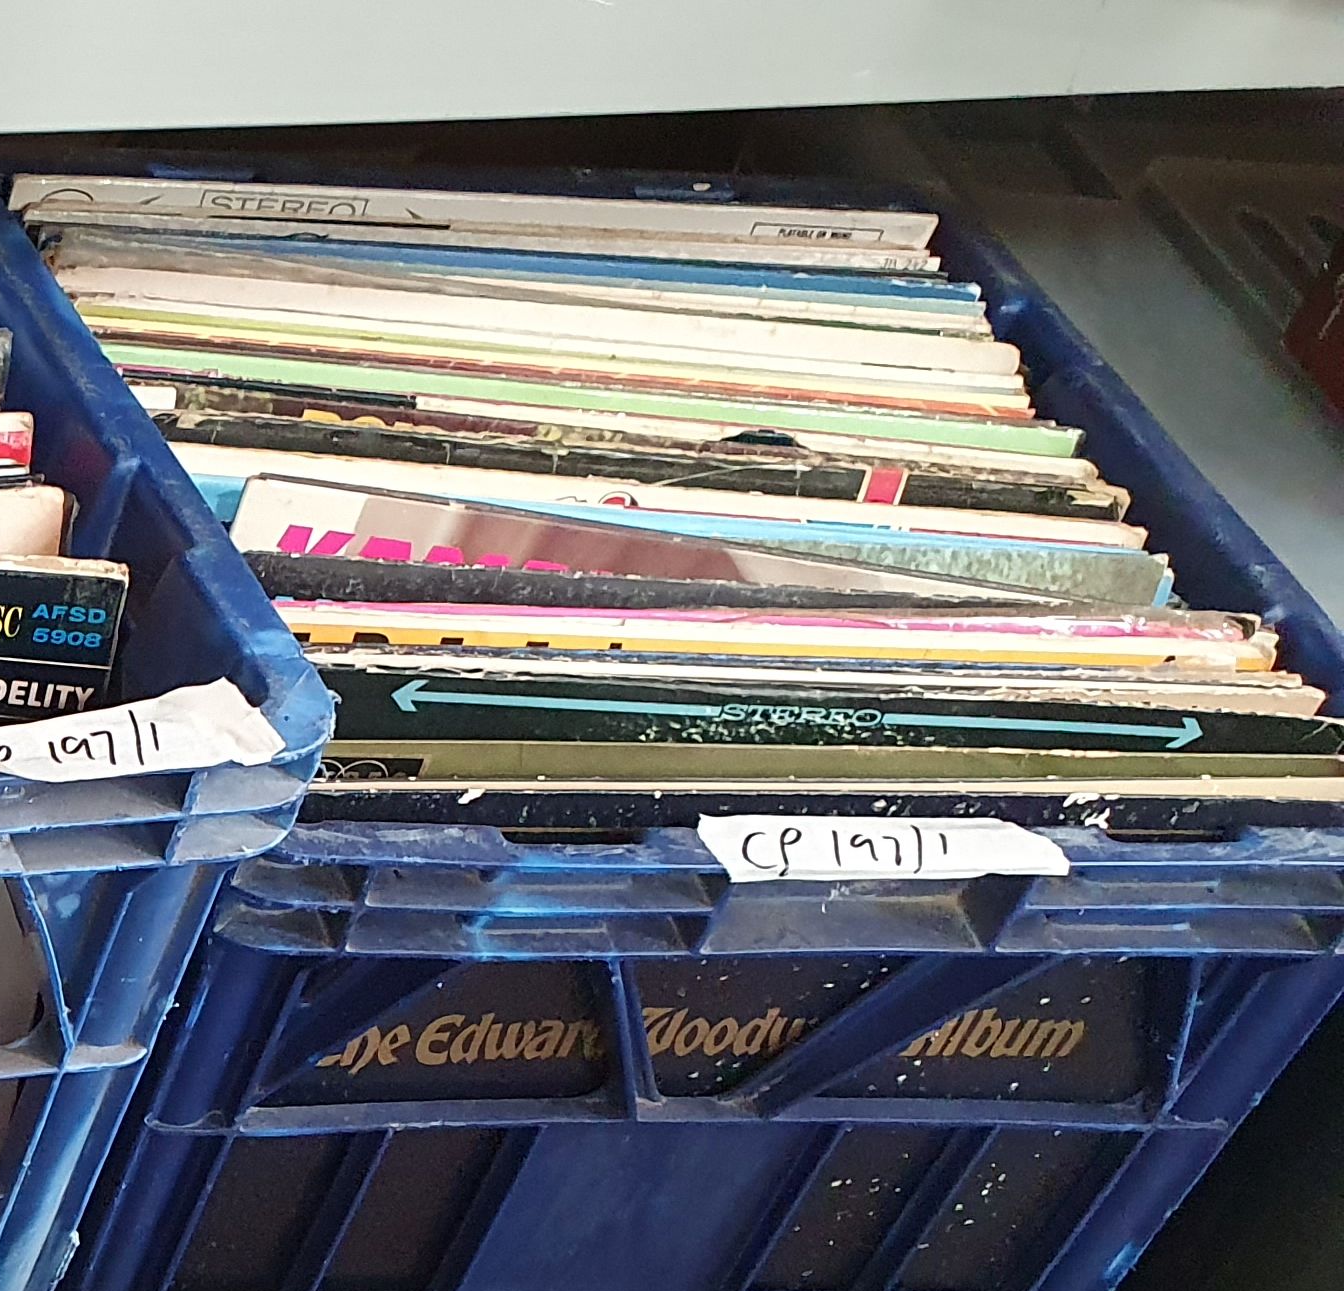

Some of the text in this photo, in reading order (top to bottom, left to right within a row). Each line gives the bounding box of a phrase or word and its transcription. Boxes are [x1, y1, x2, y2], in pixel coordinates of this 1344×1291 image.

[32, 603, 106, 624] AFSD
[716, 703, 882, 727] STEREO
[742, 826, 802, 876] CP
[416, 1012, 605, 1067] Edwar
